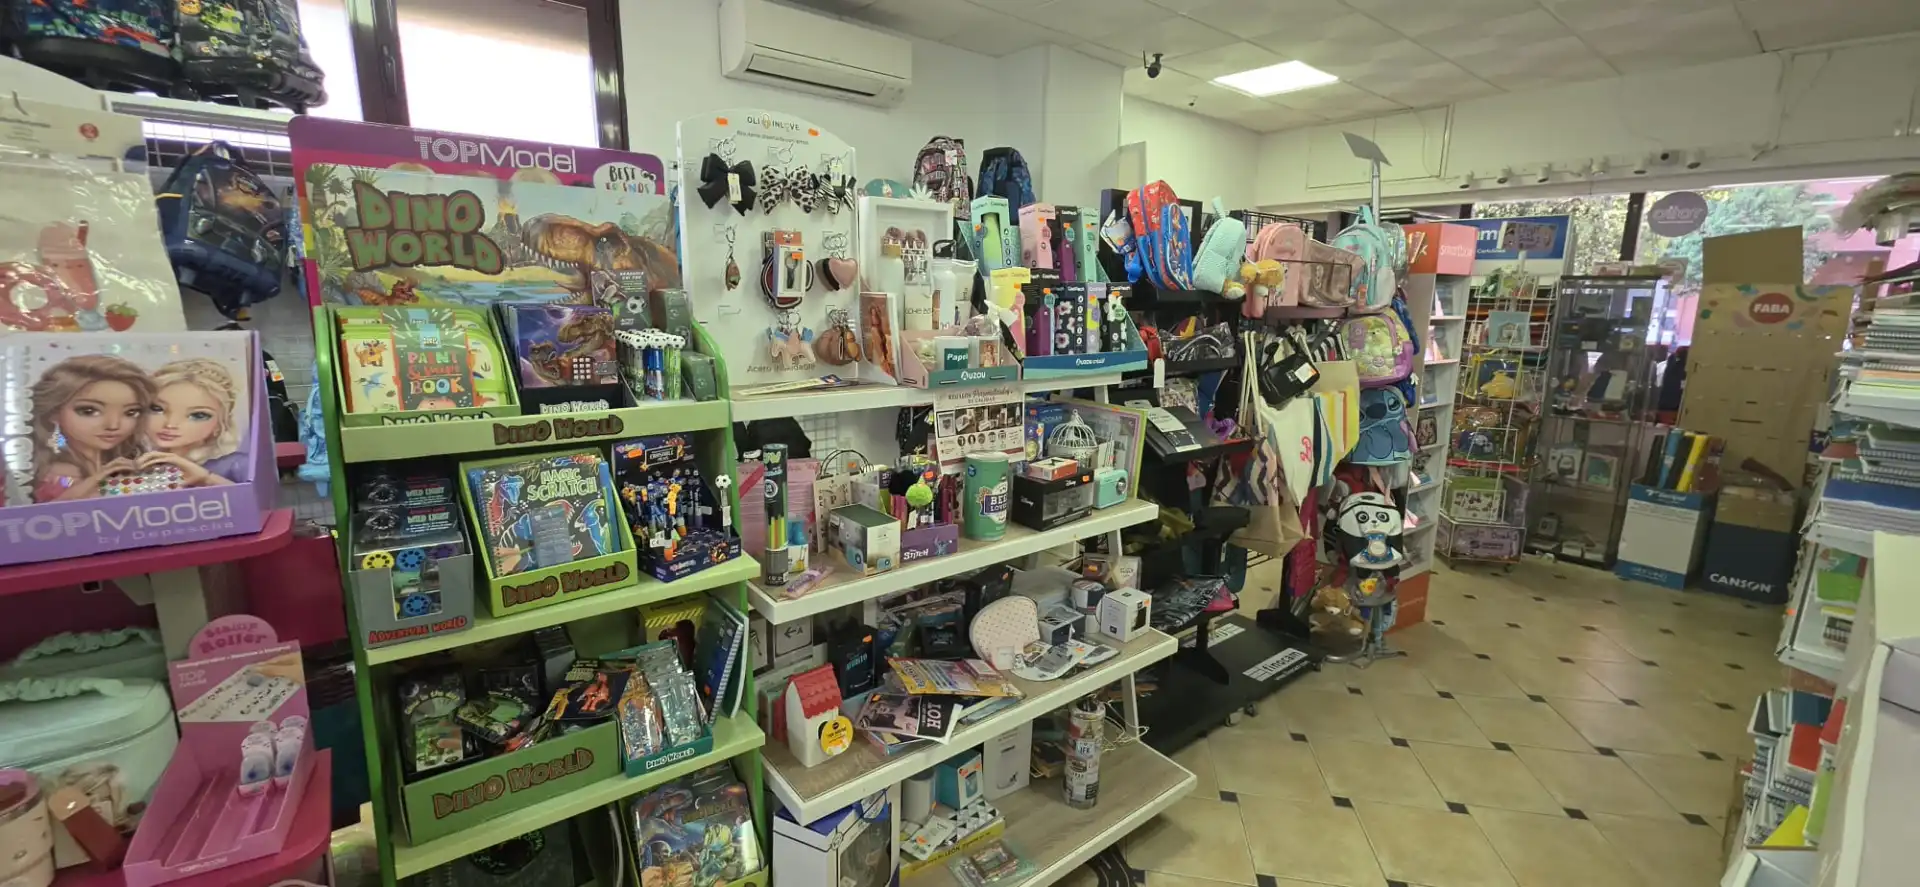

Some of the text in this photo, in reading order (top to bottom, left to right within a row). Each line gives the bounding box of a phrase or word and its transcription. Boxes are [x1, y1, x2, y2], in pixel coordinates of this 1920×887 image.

[414, 135, 577, 174] TOPModel
[609, 165, 636, 182] BEST
[353, 179, 487, 235] DINO
[346, 228, 504, 275] WORLD
[1753, 303, 1790, 314] FABA
[410, 376, 465, 395] BOOK
[540, 402, 570, 414] DINO
[493, 414, 624, 446] DINO WORLD
[540, 468, 582, 483] MAGIC
[527, 477, 597, 502] SCRATCH
[1, 491, 232, 544] TOPModel
[502, 576, 559, 608] DINO
[561, 561, 630, 593] WORLD
[1709, 572, 1772, 593] CANSON
[1262, 651, 1304, 672] finocam
[645, 747, 695, 770] DINO WORLD
[433, 748, 595, 820] DINO WORLD
